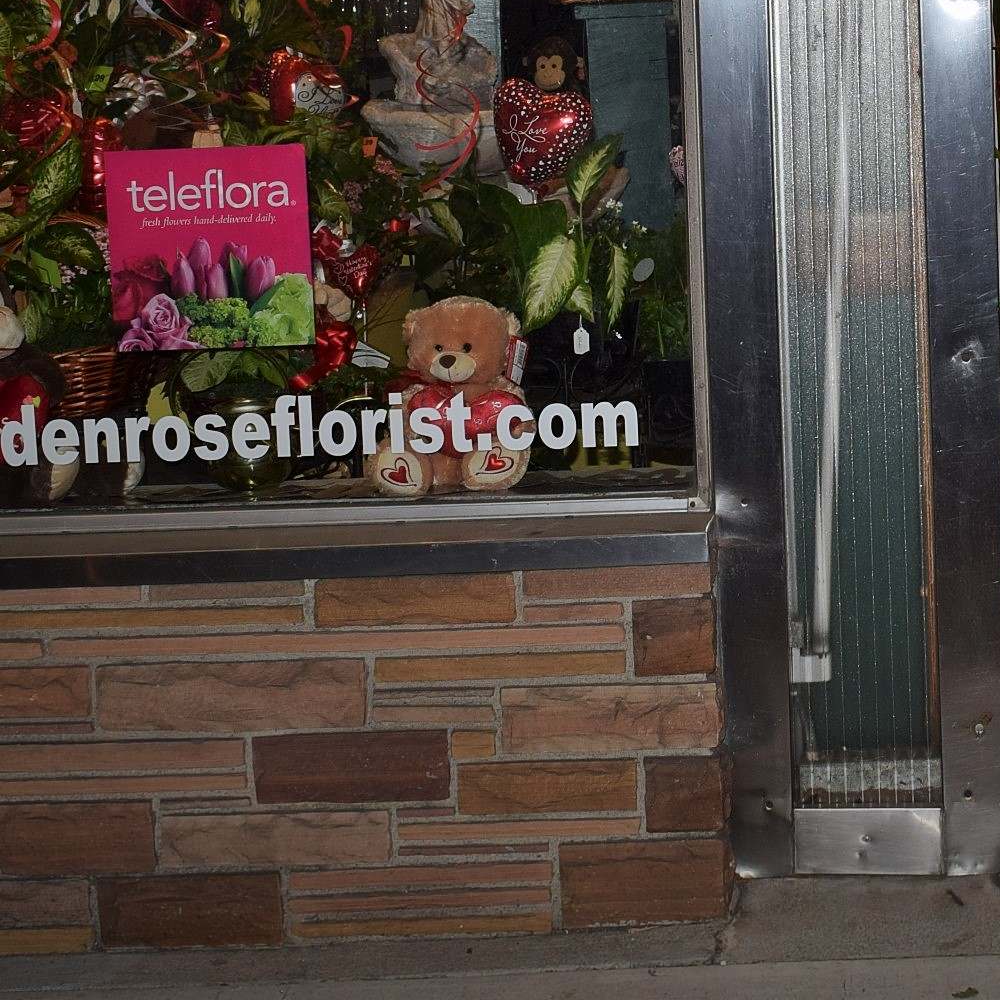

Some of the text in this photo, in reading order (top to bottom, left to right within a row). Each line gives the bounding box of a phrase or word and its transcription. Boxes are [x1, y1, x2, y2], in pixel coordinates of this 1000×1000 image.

[518, 115, 549, 143] Love
[510, 131, 537, 163] You
[126, 168, 290, 213] teleflora
[140, 212, 277, 230] fresh flowers hand-delivered daily.
[0, 390, 640, 468] denroseflorist.com
